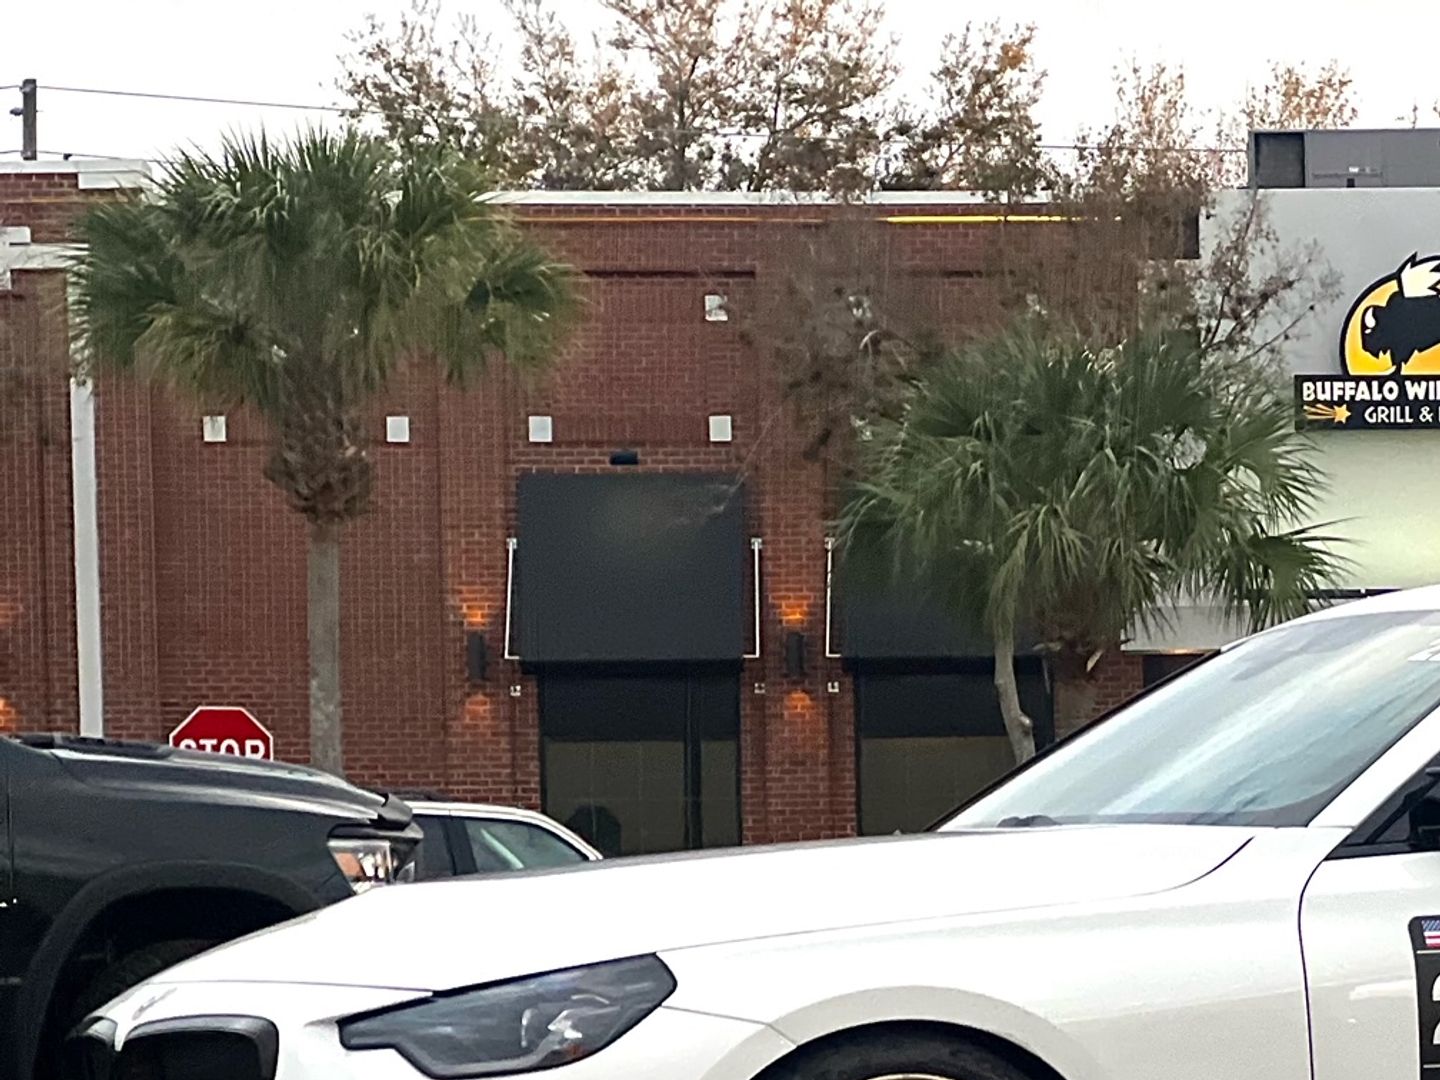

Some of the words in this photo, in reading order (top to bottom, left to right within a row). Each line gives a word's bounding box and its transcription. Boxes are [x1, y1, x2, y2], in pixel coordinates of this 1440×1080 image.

[1302, 380, 1399, 401] BUFFALO
[1364, 405, 1413, 423] GRILL
[1419, 406, 1433, 422] &
